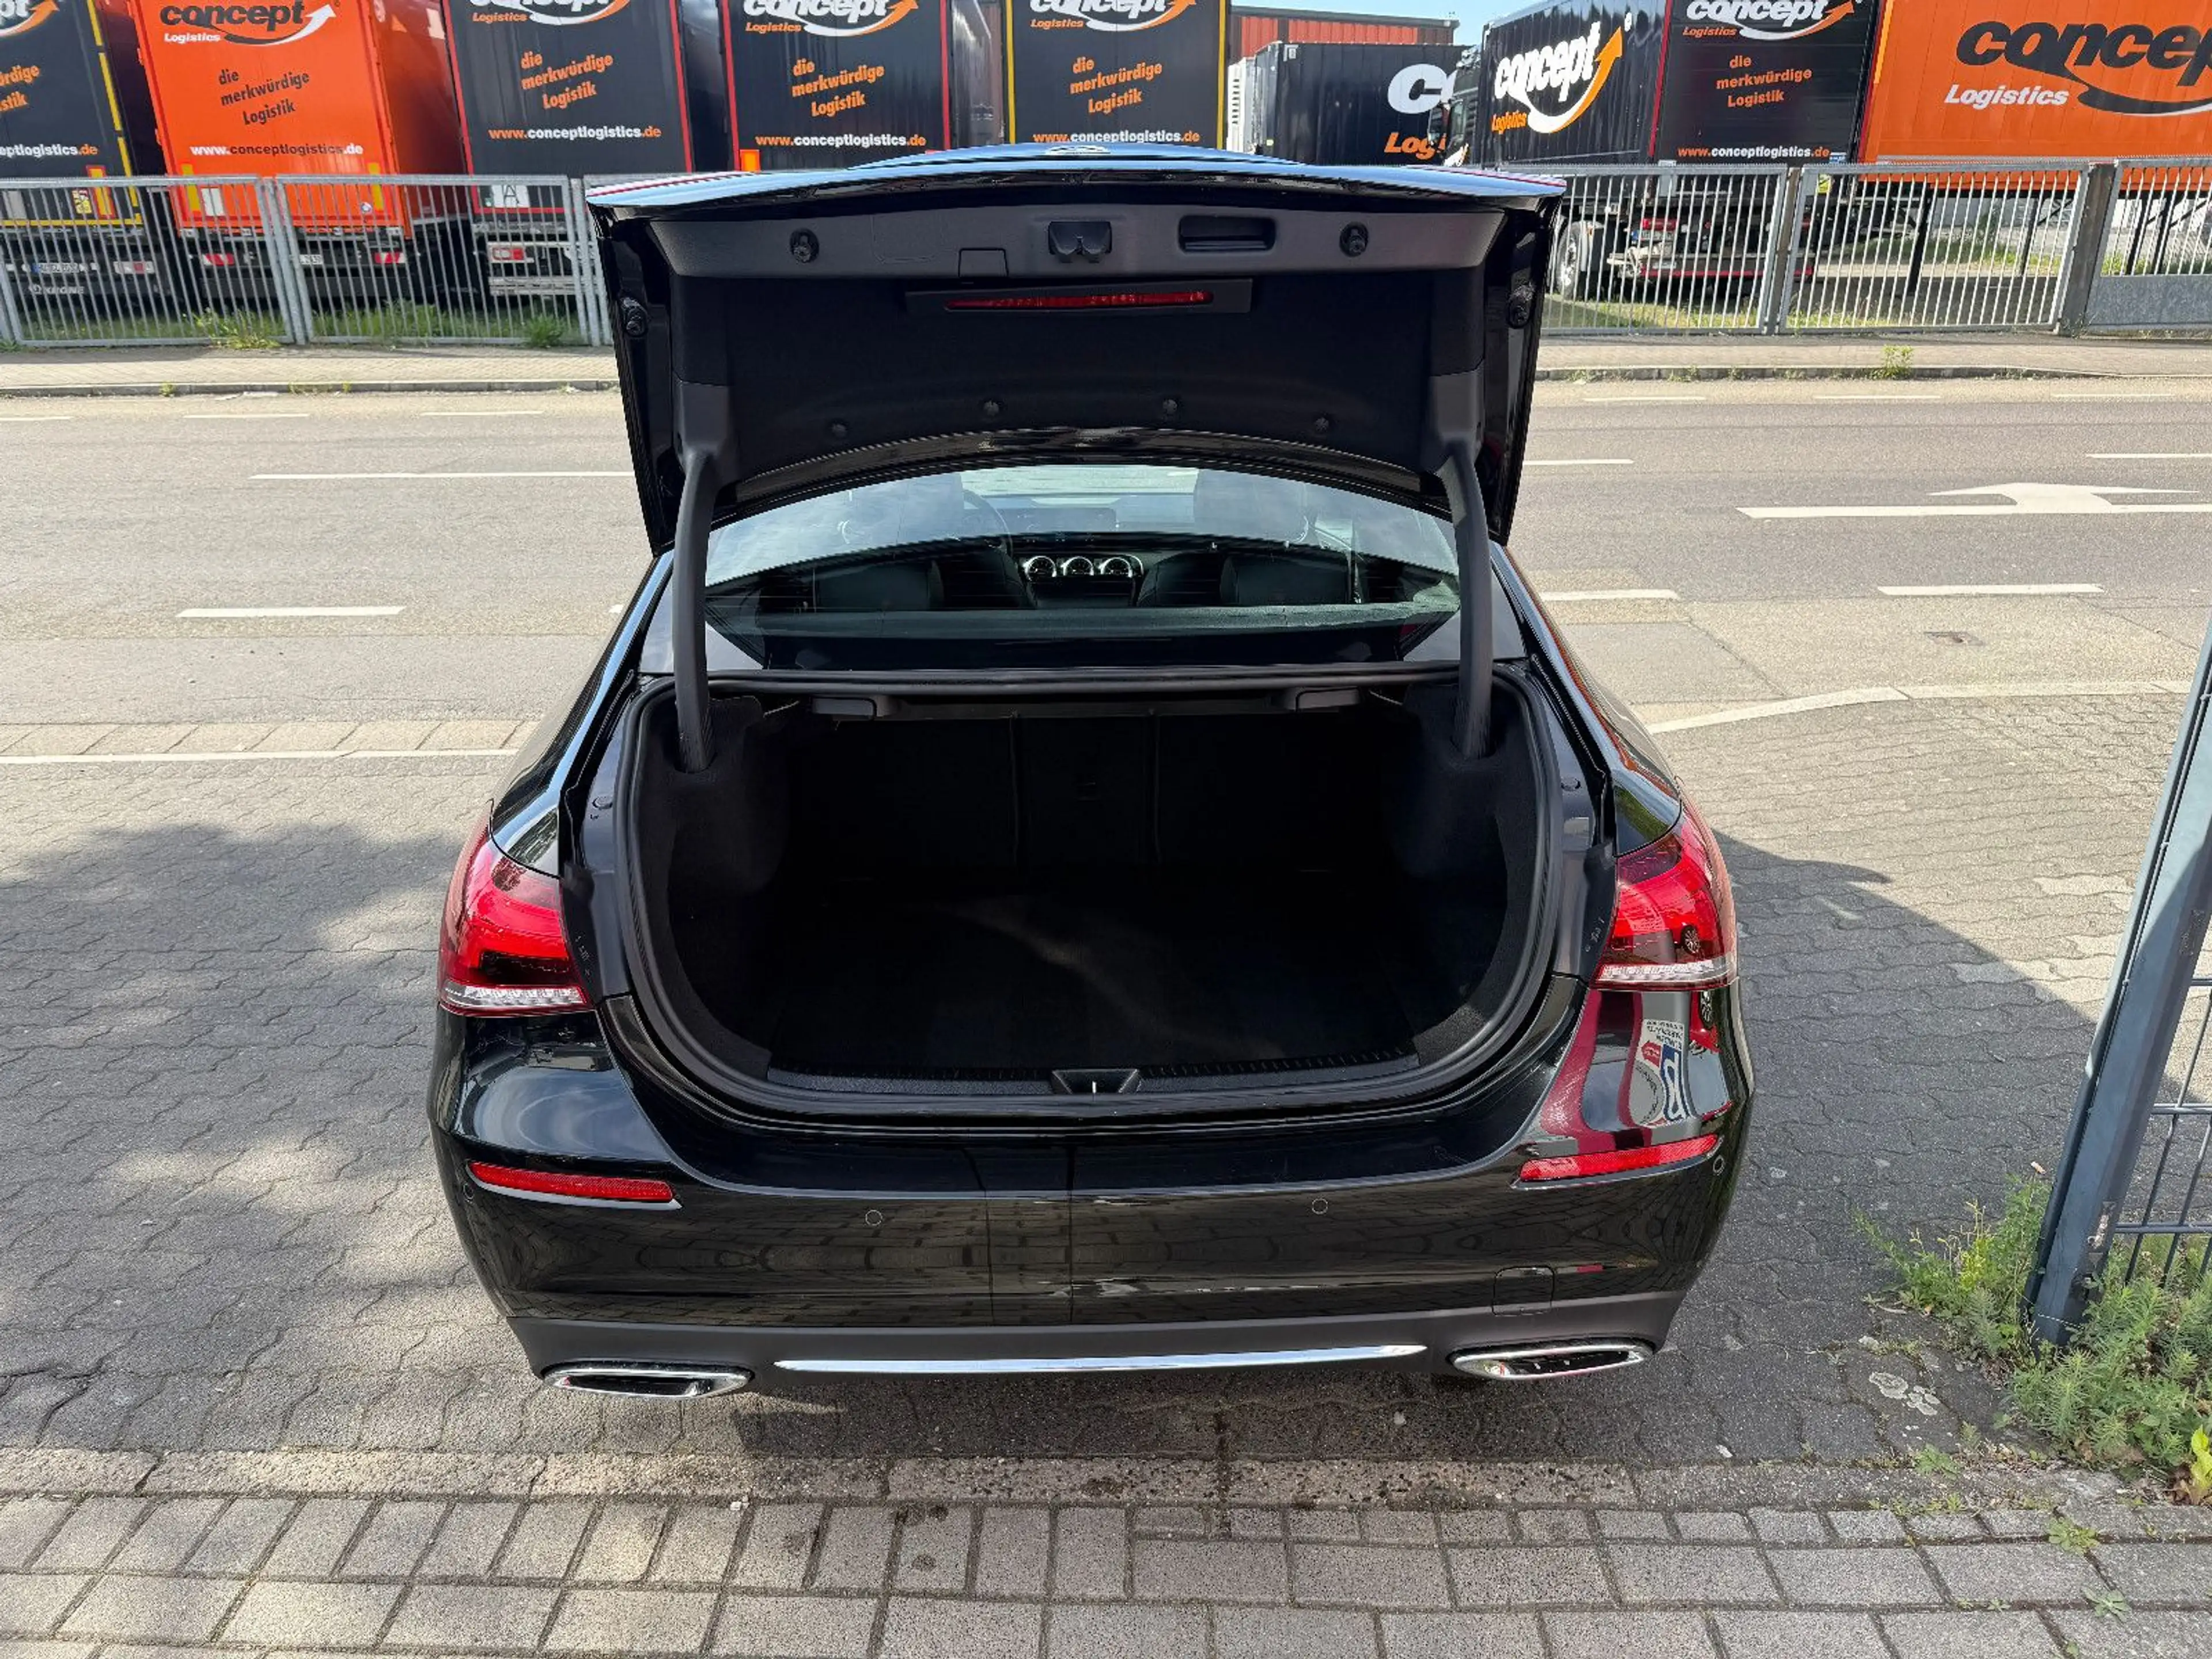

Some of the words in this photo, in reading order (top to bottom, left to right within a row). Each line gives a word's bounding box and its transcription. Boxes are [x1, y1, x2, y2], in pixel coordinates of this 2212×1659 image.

[160, 0, 305, 31] concept
[473, 12, 528, 24] Logistics
[1686, 0, 1828, 27] concept
[746, 22, 801, 34] Logistics
[1030, 18, 1084, 30] Logistics
[1683, 26, 1737, 38] Logistics
[164, 33, 220, 44] Logistics
[521, 51, 543, 69] die
[793, 58, 815, 77] die
[1073, 56, 1094, 74] die
[1494, 21, 1601, 102] concept
[1729, 55, 1752, 69] die
[218, 69, 239, 85] die
[521, 54, 613, 90] merkwürdige
[791, 65, 884, 97] merkwürdige
[1070, 62, 1162, 94] merkwürdige
[1716, 69, 1812, 89] merkwürdige
[221, 71, 309, 106] merkwürdige
[543, 81, 597, 109] Logistik
[1945, 84, 2069, 109] Logistics
[811, 90, 866, 117] Logistik
[1088, 88, 1143, 114] Logistik
[1728, 90, 1785, 108] Logistik
[243, 99, 296, 125] Logistik
[1491, 110, 1527, 135] Logistics
[488, 126, 662, 140] www.conceptlogistics.de
[755, 134, 926, 147] www.conceptlogistics.de
[1033, 130, 1199, 143] www.conceptlogistics.de
[190, 143, 363, 156] www.conceptlogistics.de
[1677, 146, 1830, 159] www.conceptlogistics.de
